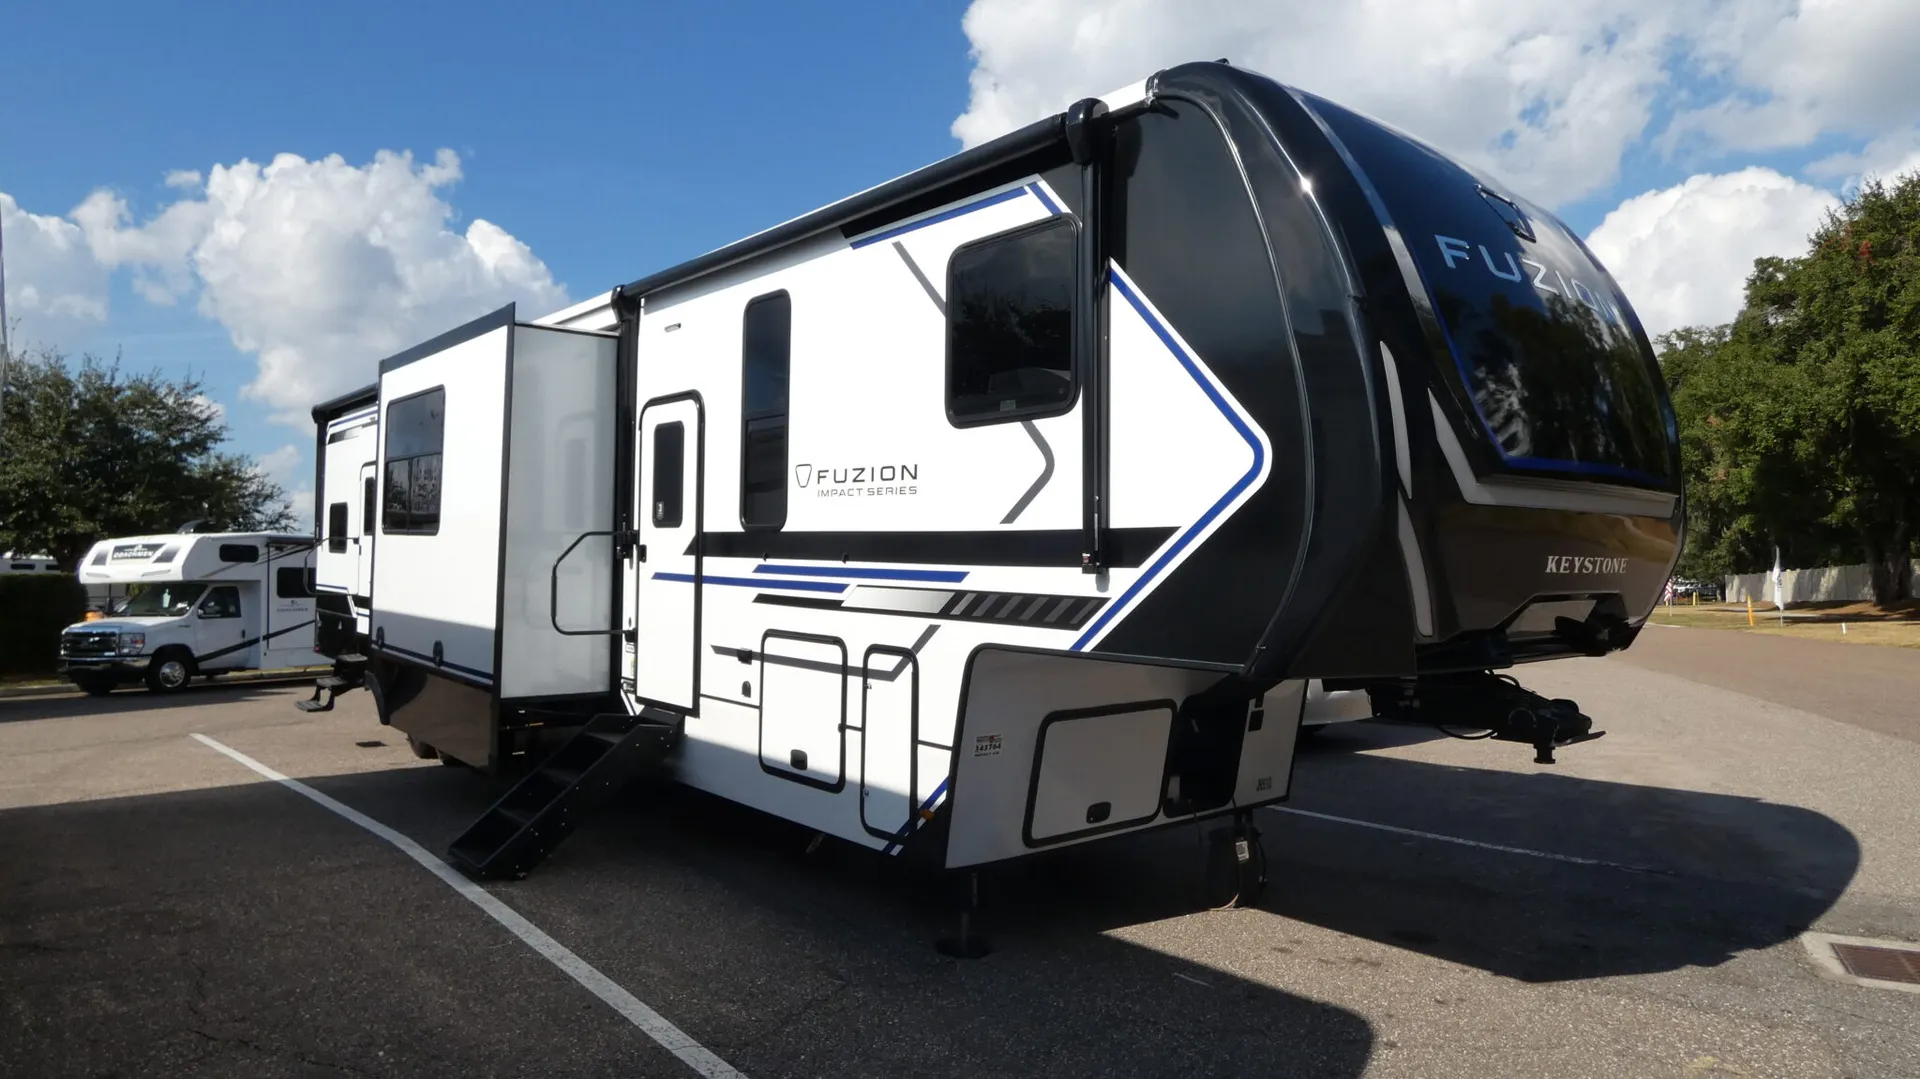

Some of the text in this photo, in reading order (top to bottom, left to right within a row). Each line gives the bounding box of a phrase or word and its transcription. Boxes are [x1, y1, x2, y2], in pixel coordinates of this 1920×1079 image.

[1434, 234, 1618, 320] FUZION
[817, 464, 918, 484] FUZION
[817, 486, 918, 498] IMPACT SERIES
[1545, 555, 1628, 574] KEYSTONE
